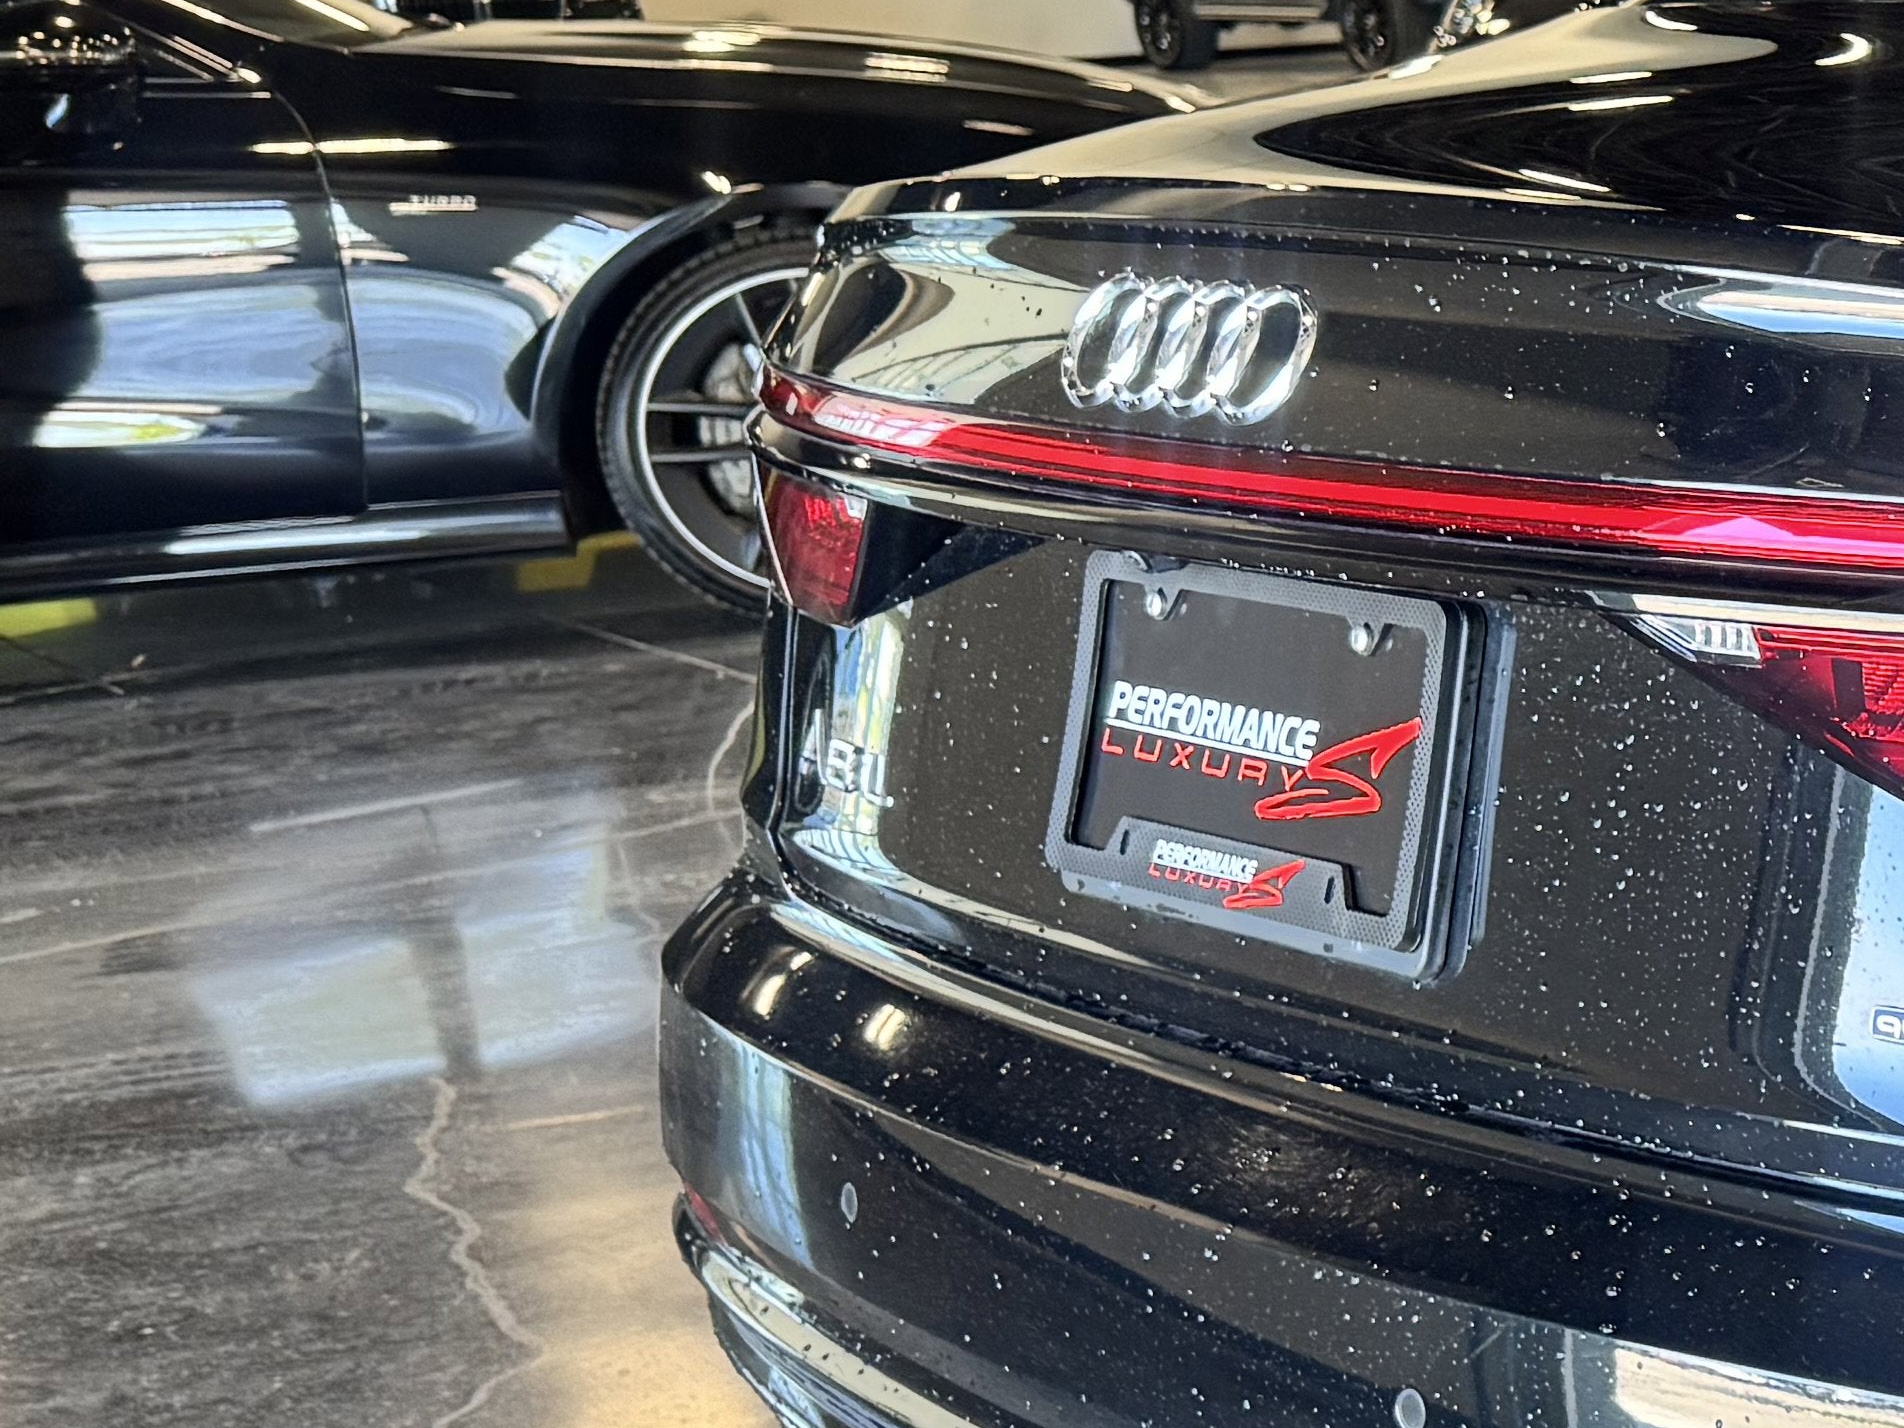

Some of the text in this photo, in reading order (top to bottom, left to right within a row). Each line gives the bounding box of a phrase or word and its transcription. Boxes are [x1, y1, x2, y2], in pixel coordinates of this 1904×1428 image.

[1109, 680, 1321, 761] PERFORMANCE
[1101, 727, 1303, 792] LUXURY
[1148, 862, 1249, 894] LUXURY
[1153, 838, 1259, 881] PERFORMANCE
